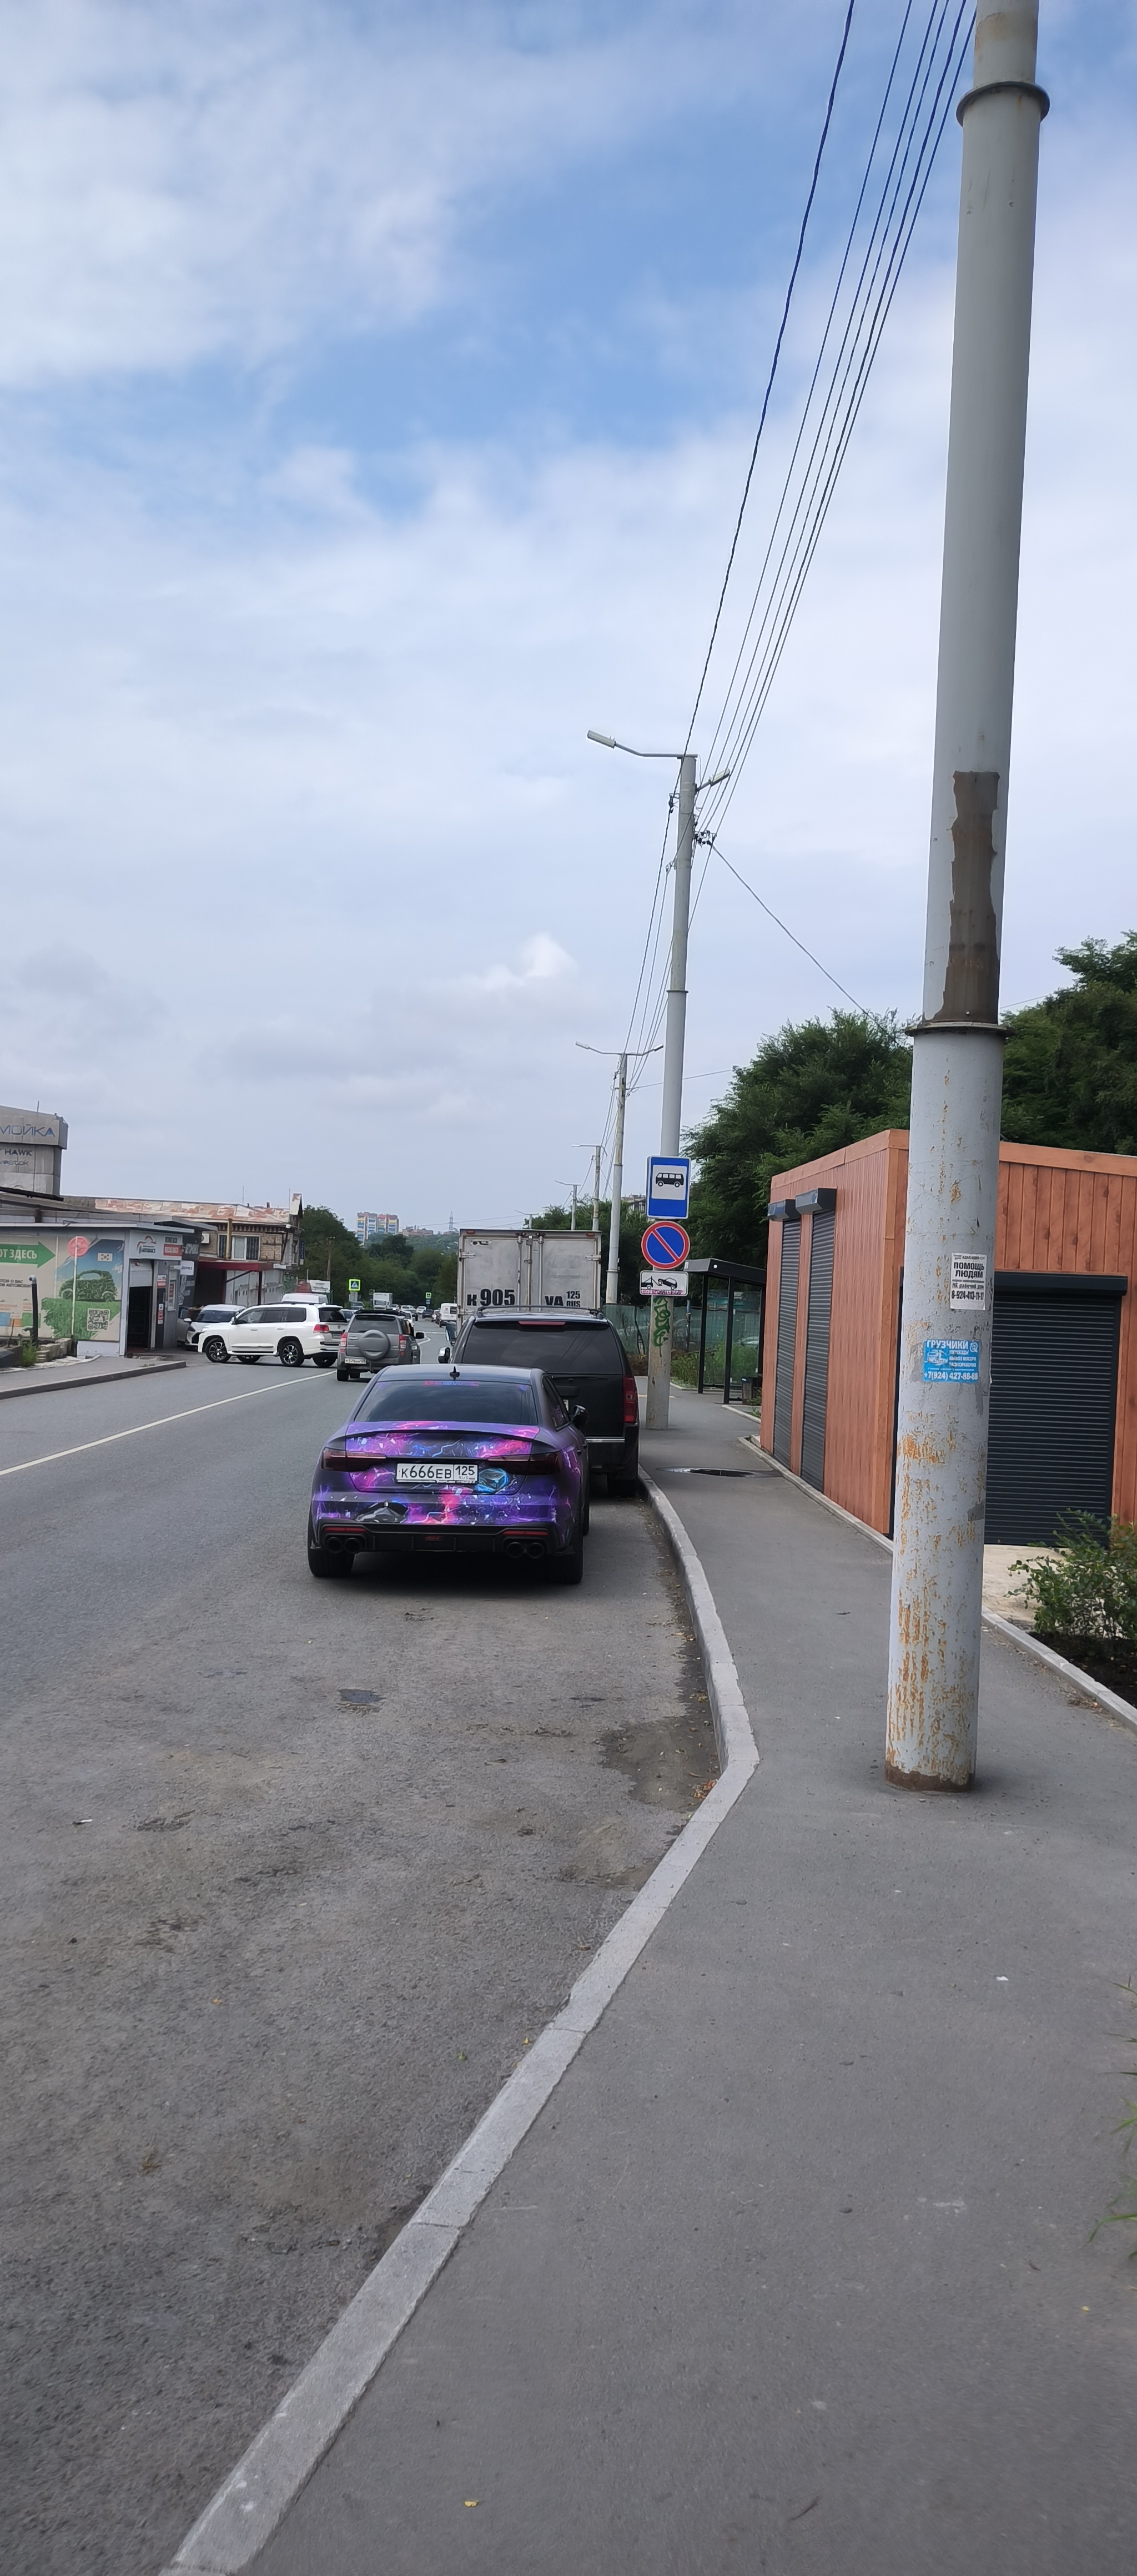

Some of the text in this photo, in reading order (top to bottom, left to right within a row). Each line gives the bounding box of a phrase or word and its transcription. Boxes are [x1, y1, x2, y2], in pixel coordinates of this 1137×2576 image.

[9, 1249, 37, 1260] ЗДЕСЬ
[953, 1262, 985, 1271] ПОМОЩЬ
[955, 1270, 983, 1279] ЛЮДЯМ
[480, 1289, 515, 1306] 905
[566, 1291, 581, 1299] 125
[951, 1290, 984, 1300] 8-924-413-11-11
[927, 1340, 969, 1349] ГРУЗЧИКИ
[924, 1371, 948, 1381] +7(924)
[455, 1466, 475, 1476] 125
